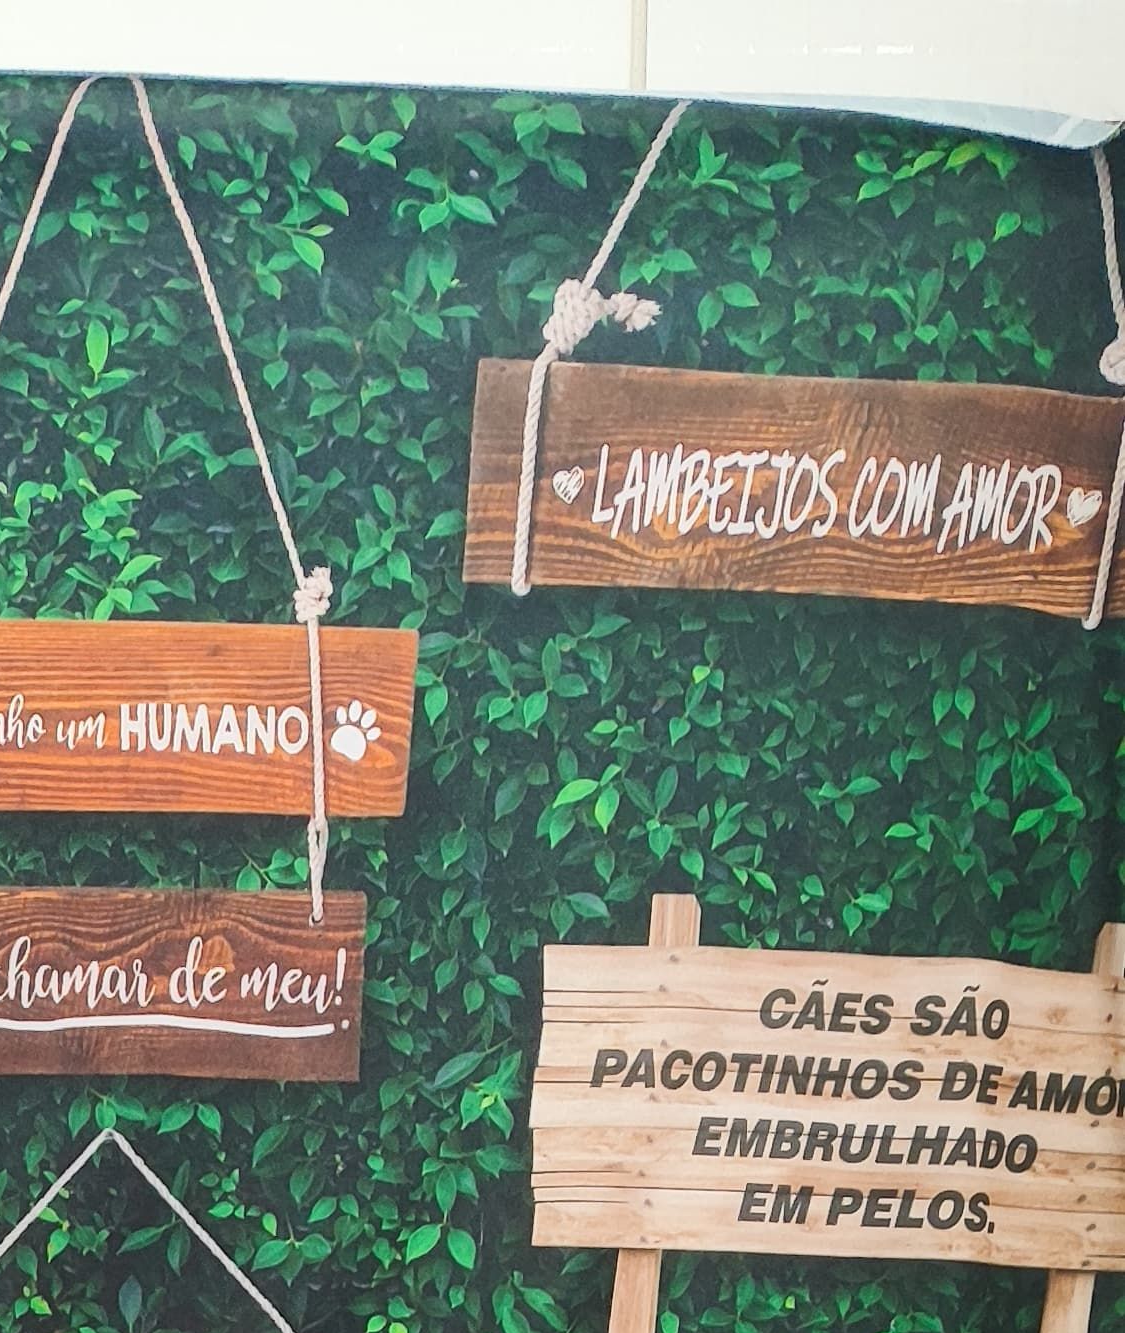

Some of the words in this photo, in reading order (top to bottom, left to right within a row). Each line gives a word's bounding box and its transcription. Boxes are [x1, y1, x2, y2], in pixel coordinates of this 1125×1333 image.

[591, 443, 846, 540] LAMBEIJOS
[848, 453, 942, 539] COM
[936, 459, 1063, 554] AMOR
[57, 711, 110, 750] um
[120, 702, 310, 755] HUMANO
[169, 935, 227, 1009] de
[240, 947, 347, 1014] meu!
[760, 979, 894, 1035] CÃES
[910, 984, 1010, 1040] SÃO
[589, 1049, 924, 1100] PACOTINHOS
[938, 1061, 1003, 1105] DE
[1008, 1070, 1125, 1117] AMO
[692, 1117, 1037, 1173] EMBRULHADO
[738, 1183, 812, 1226] EM
[826, 1188, 995, 1234] PELOS.
